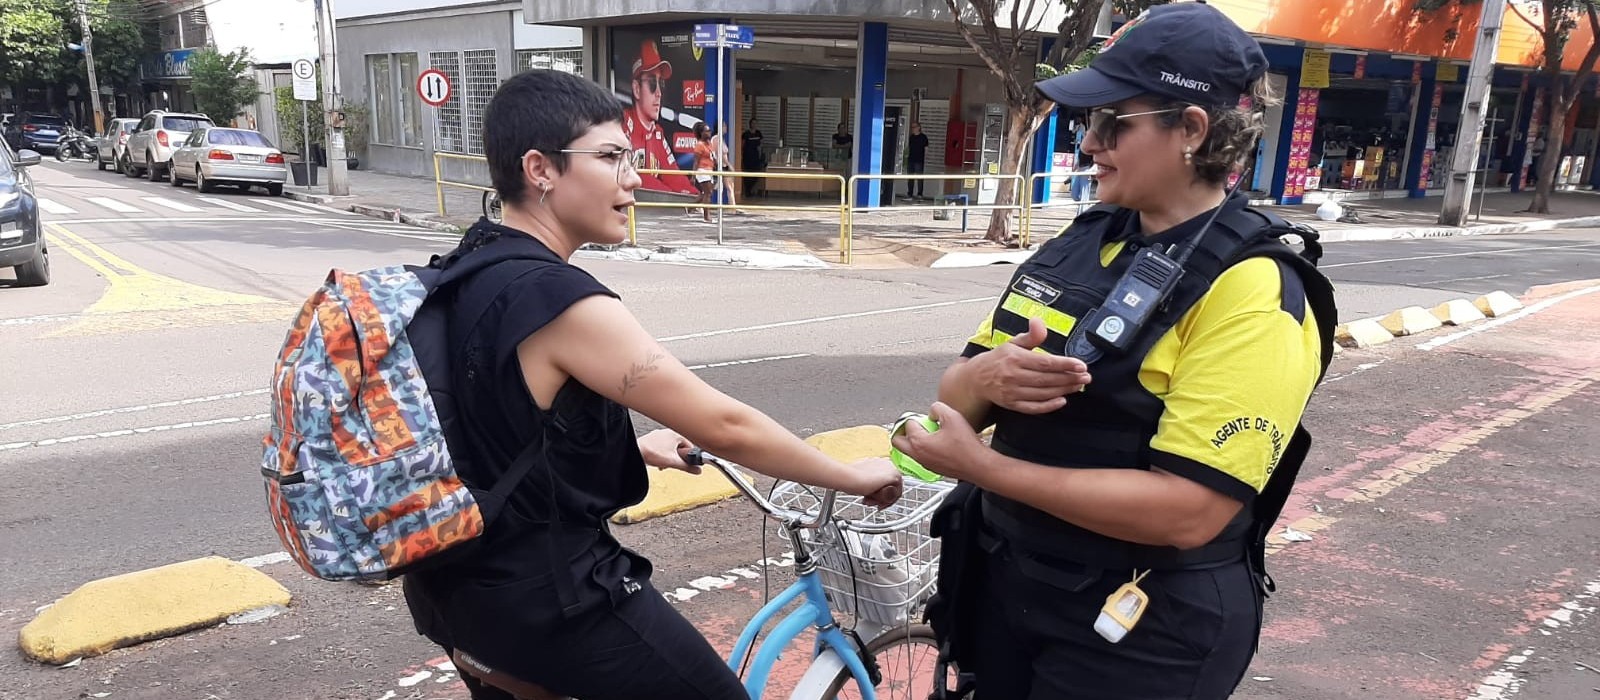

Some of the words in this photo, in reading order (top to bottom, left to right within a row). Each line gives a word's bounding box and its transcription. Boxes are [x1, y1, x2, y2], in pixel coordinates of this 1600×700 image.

[300, 63, 307, 75] E
[1160, 71, 1211, 92] TRÂNSITO
[1210, 417, 1250, 449] AGENTE
[1255, 417, 1270, 432] DE
